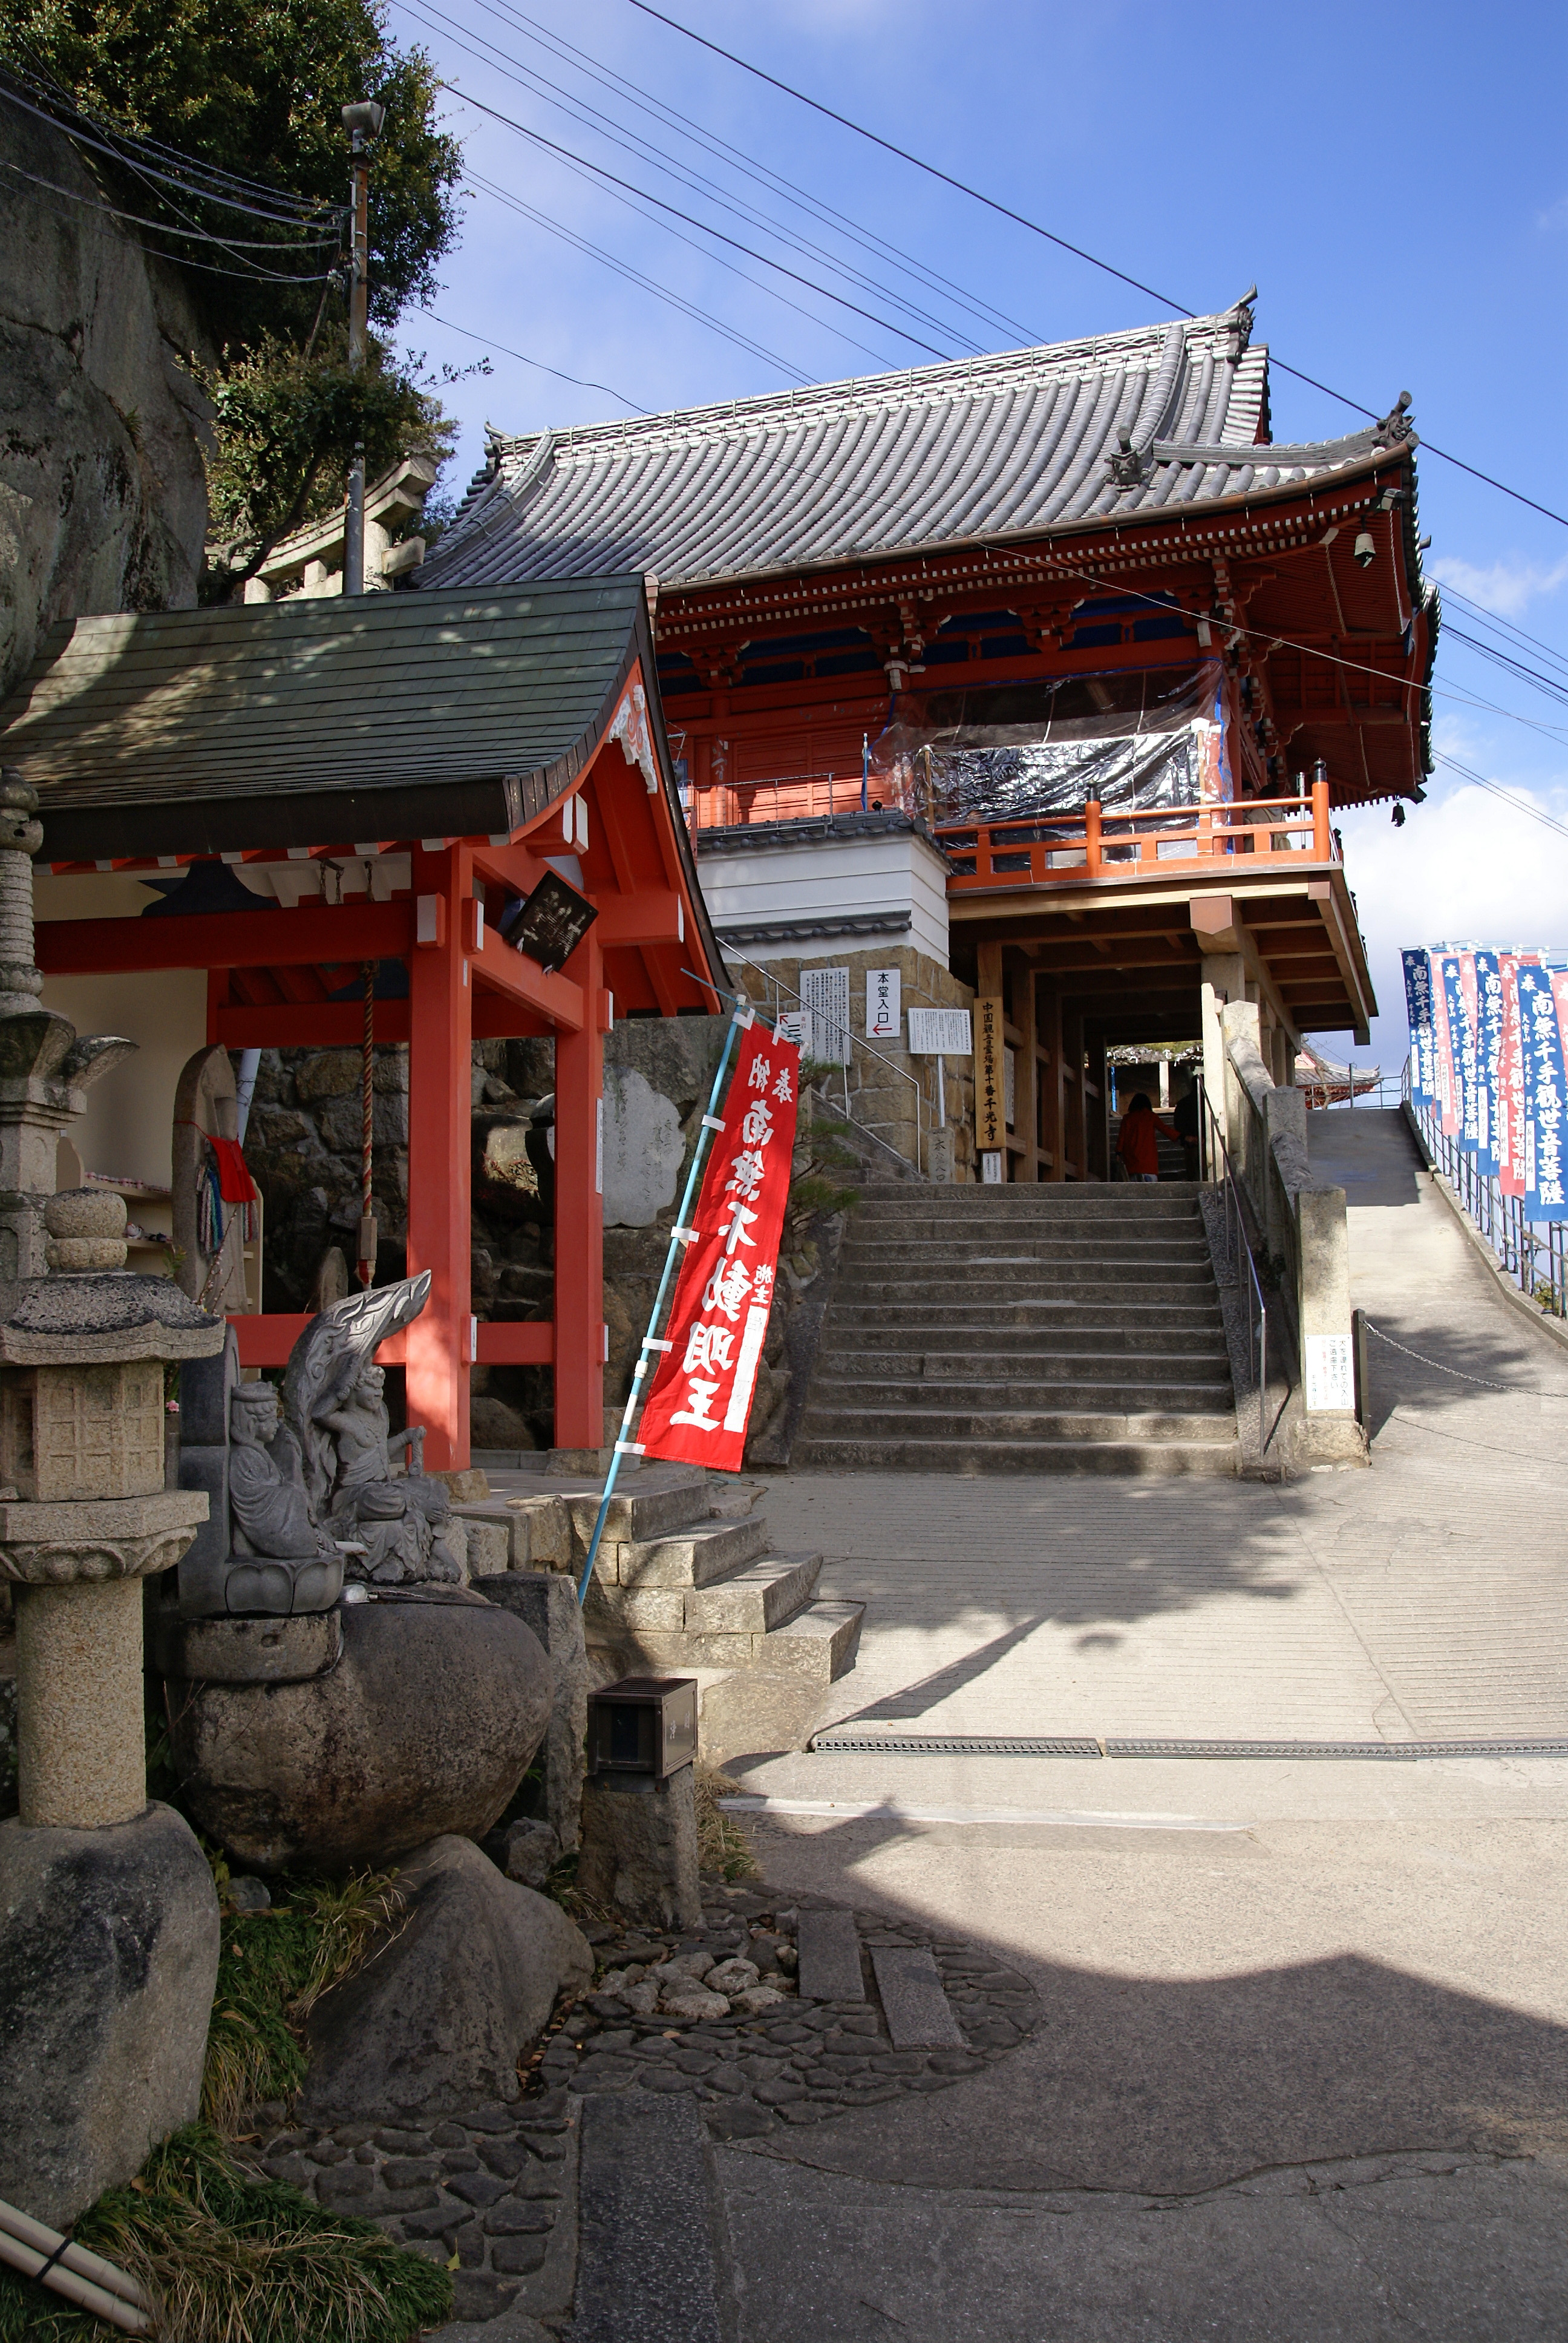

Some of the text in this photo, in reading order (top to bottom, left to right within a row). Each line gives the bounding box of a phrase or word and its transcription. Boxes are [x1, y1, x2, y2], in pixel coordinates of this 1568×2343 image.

[1445, 964, 1459, 978] 奉
[1477, 957, 1490, 973] 奉
[1501, 963, 1514, 980] 奉
[877, 972, 889, 1023] 本堂入口
[1520, 974, 1538, 992] 奉
[1532, 990, 1566, 1205] 南無千手観世音菩薩
[1329, 1339, 1339, 1389] ご遠慮下さい
[1339, 1340, 1349, 1406] 犬を連れての入山
